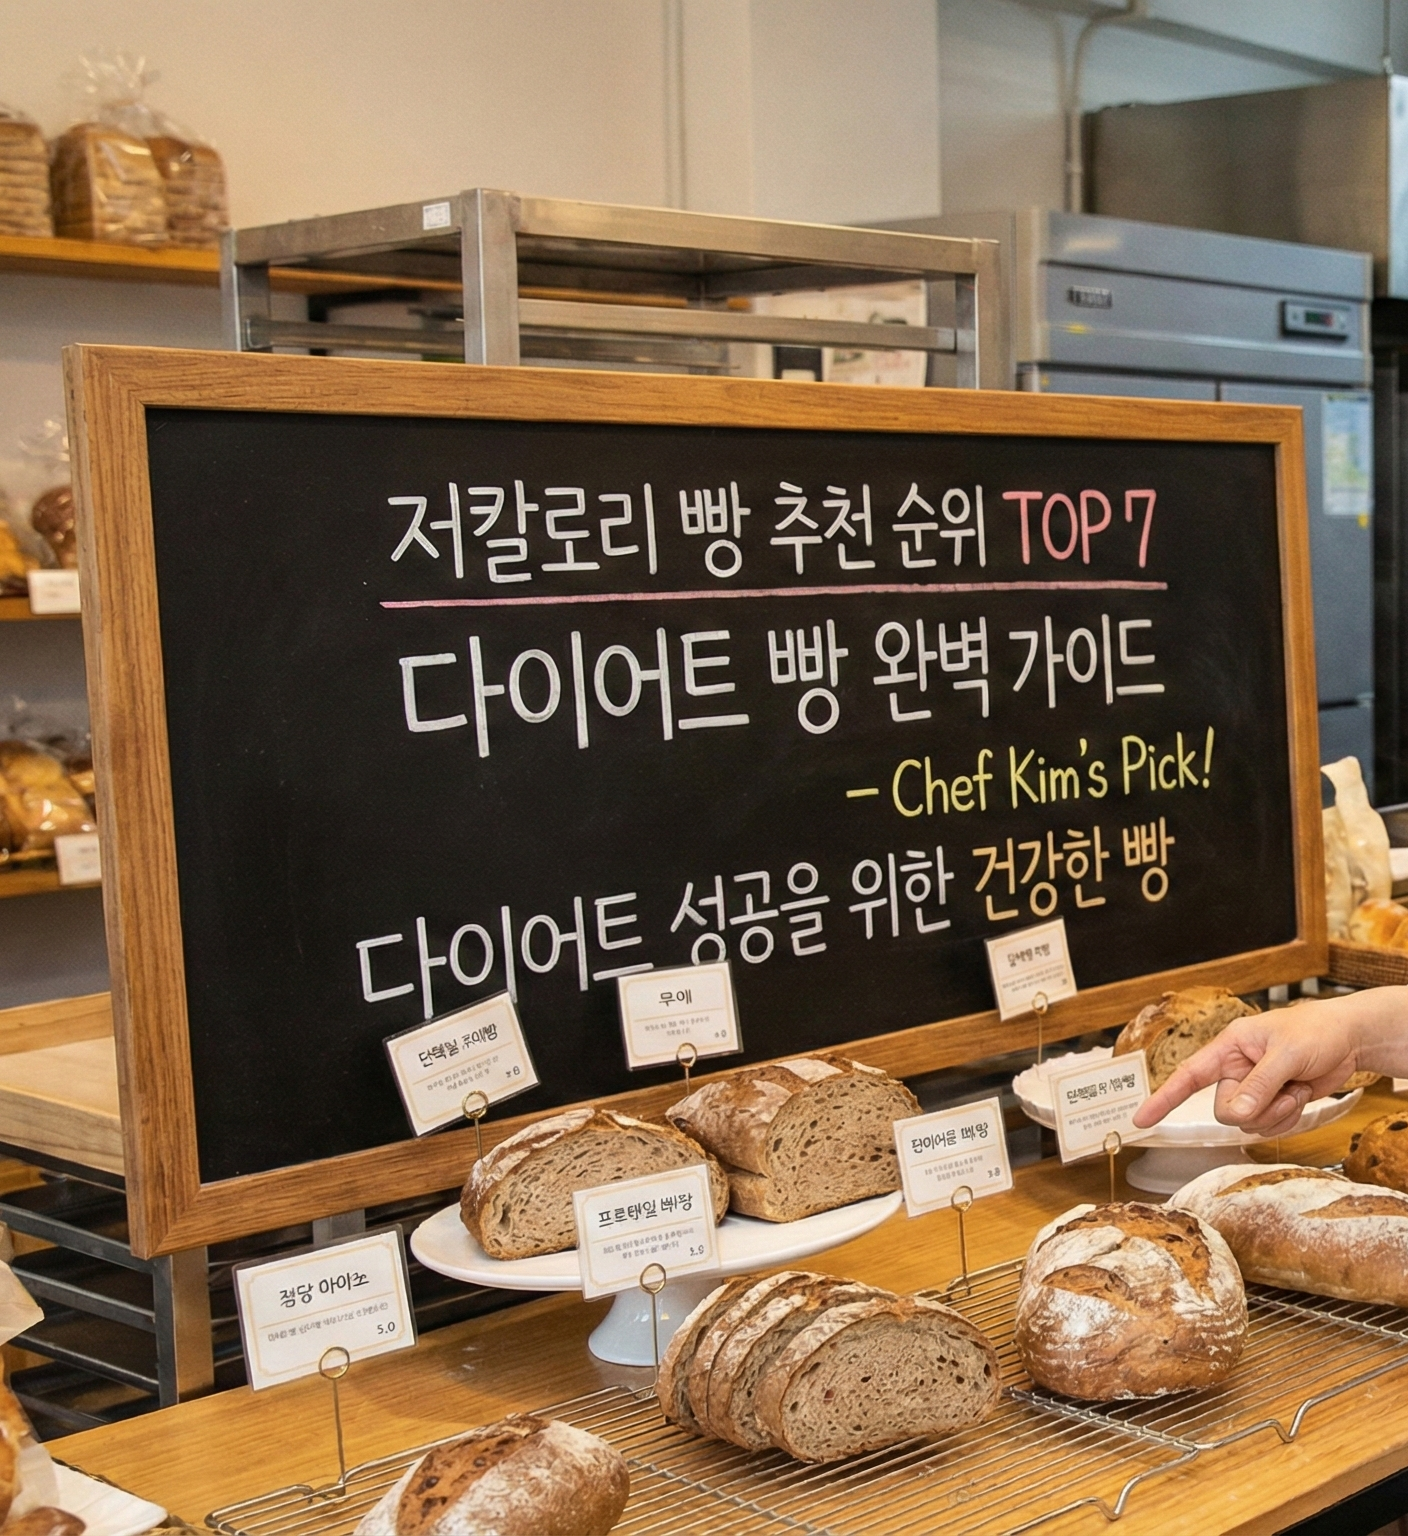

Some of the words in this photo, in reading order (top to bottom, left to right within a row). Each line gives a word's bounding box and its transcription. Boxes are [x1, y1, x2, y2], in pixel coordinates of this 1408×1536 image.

[388, 480, 658, 583] 저칼로리
[679, 481, 751, 578] 빵
[769, 481, 876, 575] 추천
[892, 482, 986, 568] 순위
[1002, 488, 1112, 565] TOP
[1125, 488, 1157, 568] 7
[399, 627, 750, 758] 다이어트
[767, 619, 849, 734] 빵
[873, 616, 990, 722] 완벽
[1009, 613, 1165, 708] 가이드
[892, 749, 993, 817] Chef
[1009, 738, 1109, 809] Kim's
[1122, 726, 1215, 795] Pick!
[356, 892, 654, 1021] 다이어트
[670, 861, 831, 966] 성공을
[849, 845, 954, 940] 위한
[972, 825, 1110, 921] 건강한
[1122, 816, 1175, 902] 빵
[377, 1321, 396, 1335] 5.0
